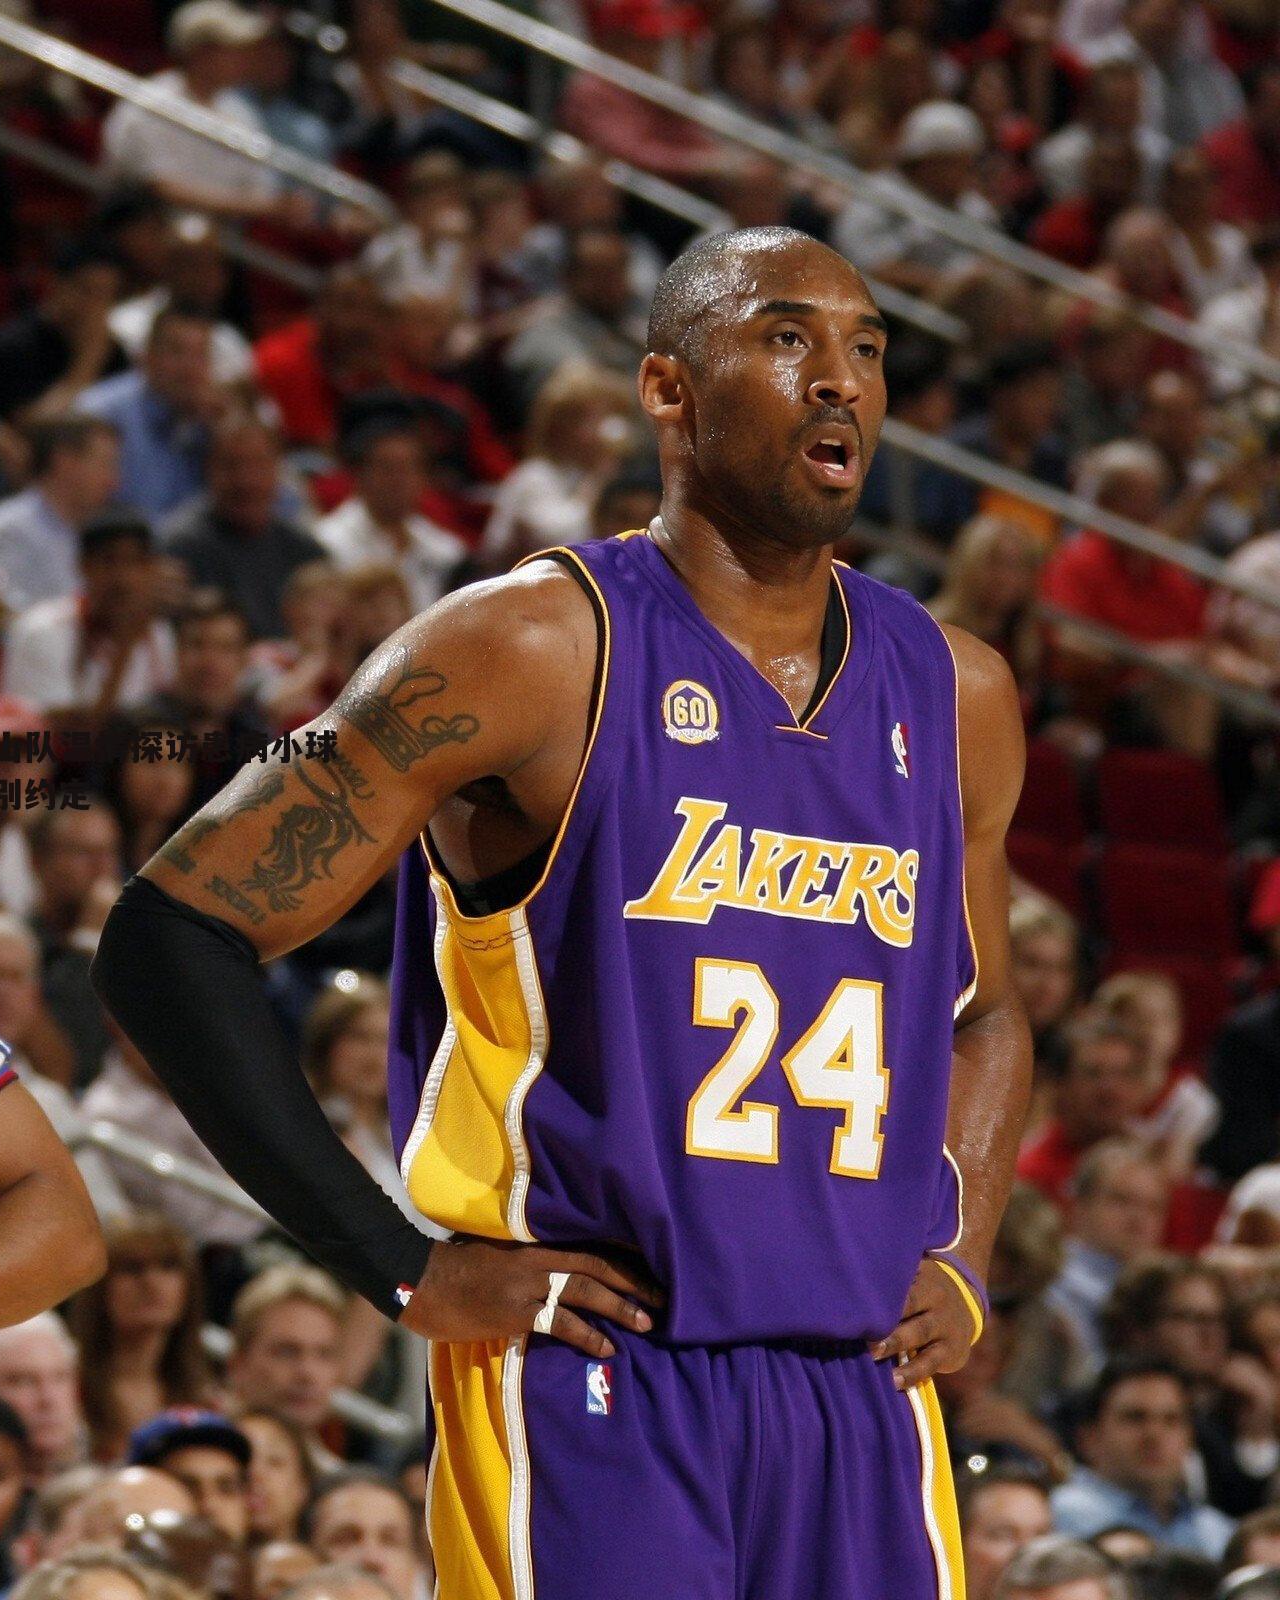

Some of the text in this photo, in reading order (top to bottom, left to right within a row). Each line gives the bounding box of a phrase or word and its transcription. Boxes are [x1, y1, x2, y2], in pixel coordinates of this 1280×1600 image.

[674, 696, 706, 727] 60
[623, 796, 921, 949] LAKERS
[685, 956, 891, 1181] 24
